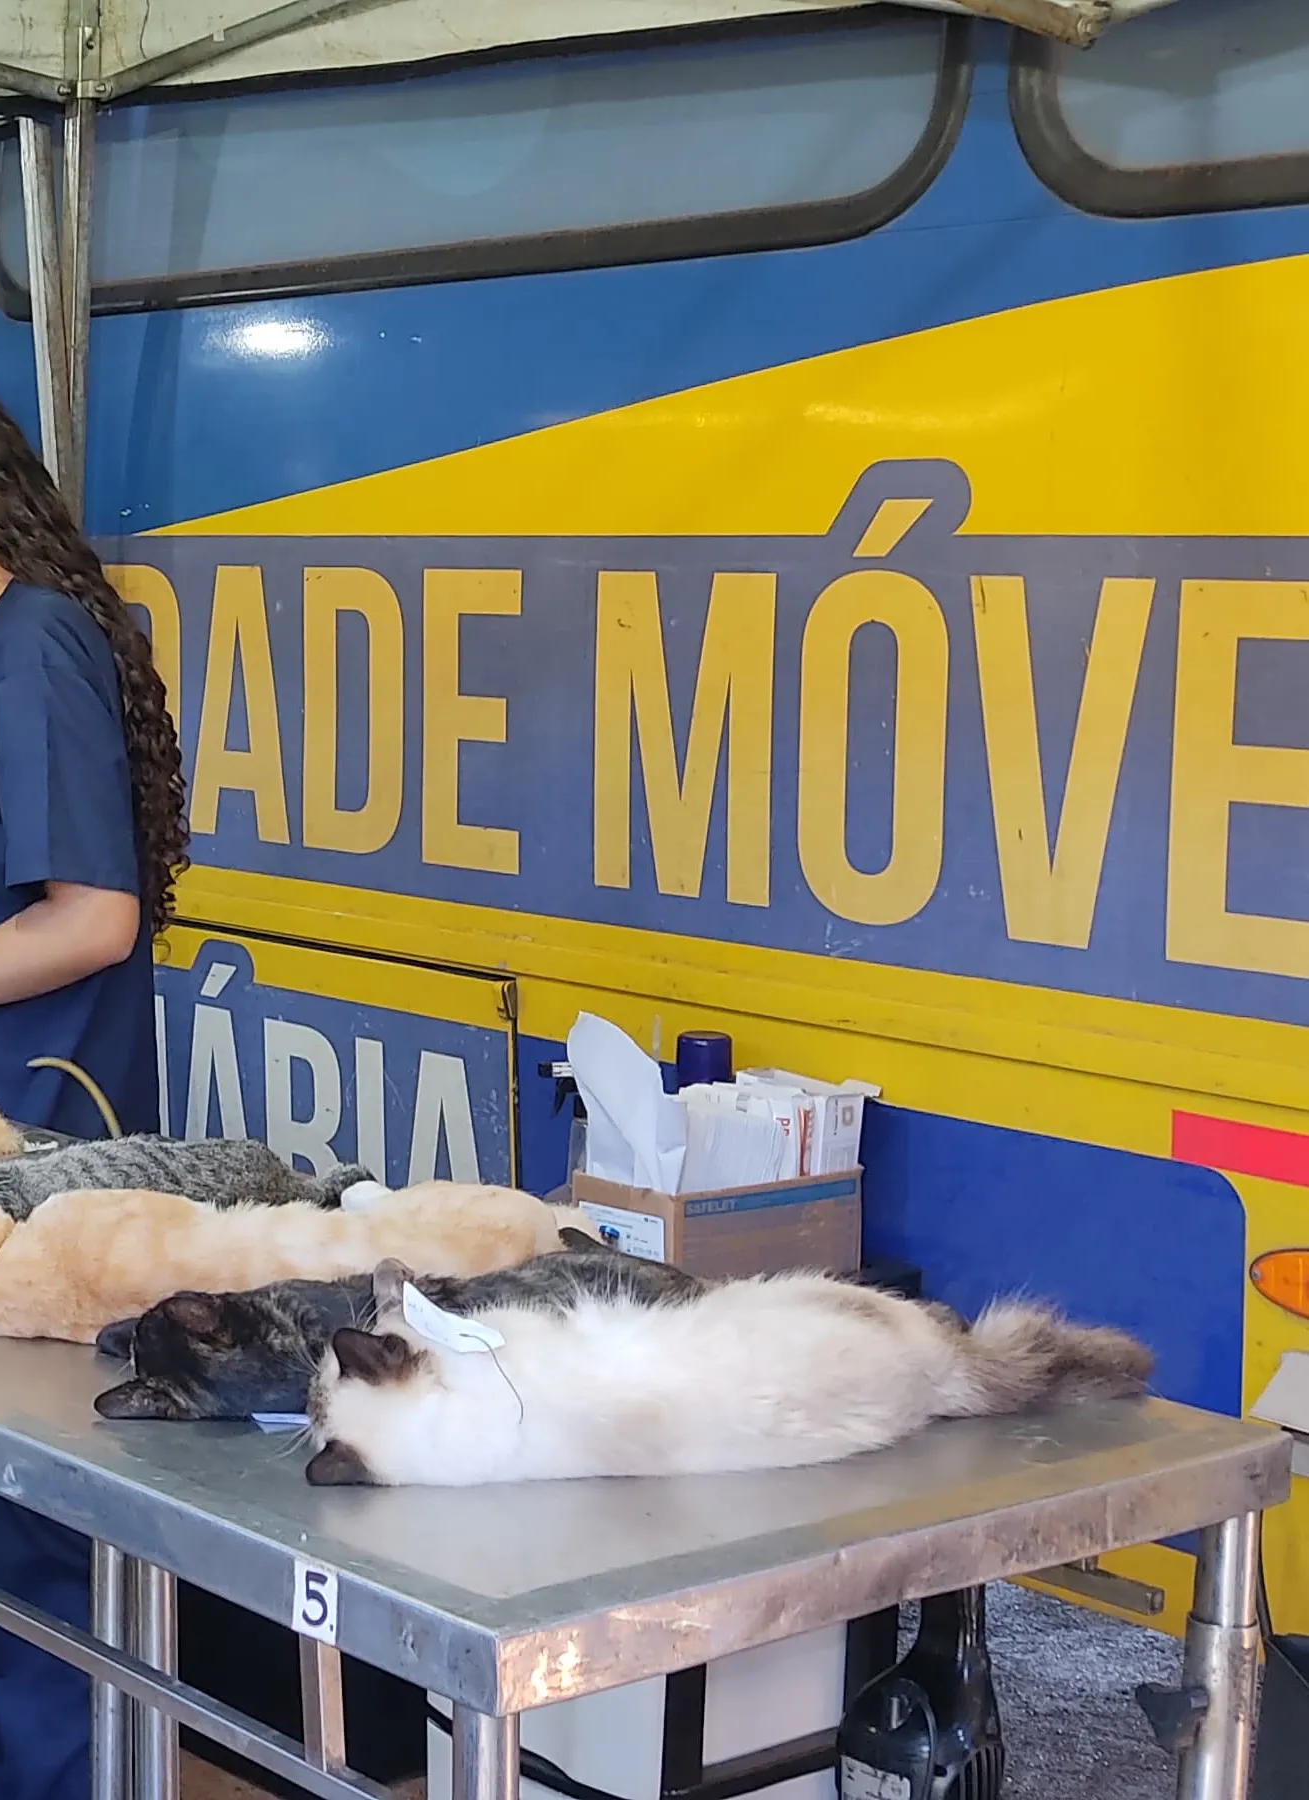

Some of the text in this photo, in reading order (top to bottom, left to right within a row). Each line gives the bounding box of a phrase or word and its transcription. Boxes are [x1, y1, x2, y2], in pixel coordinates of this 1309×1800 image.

[593, 497, 1309, 980] MÓVE
[154, 962, 481, 1186] ÁRIA
[301, 1568, 334, 1632] 5.
